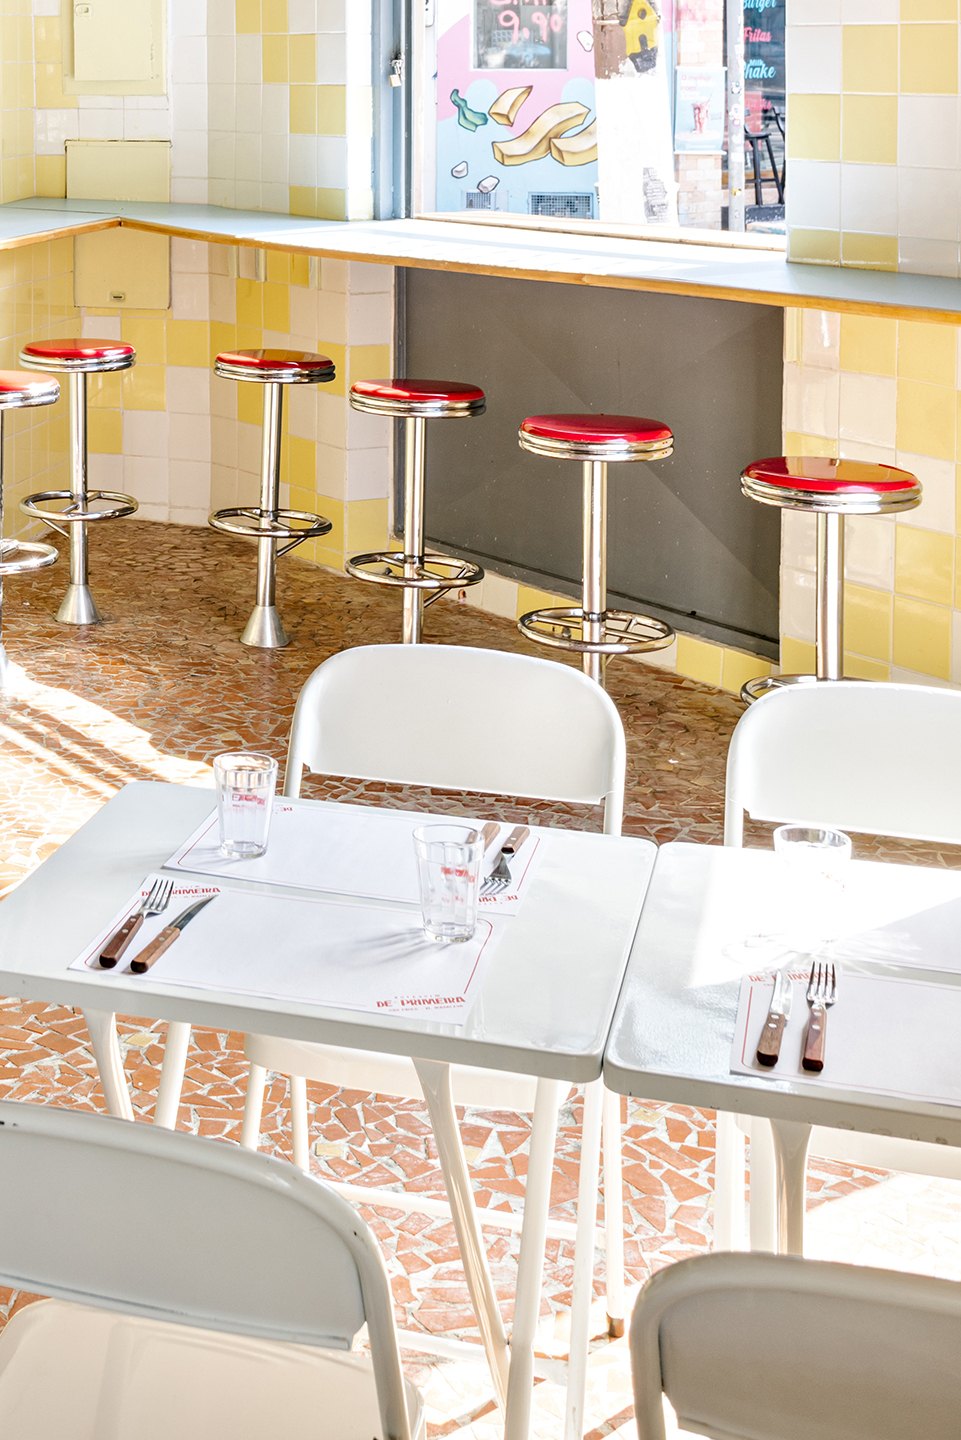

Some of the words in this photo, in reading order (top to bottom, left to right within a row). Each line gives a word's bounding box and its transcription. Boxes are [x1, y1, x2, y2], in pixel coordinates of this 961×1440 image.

[498, 9, 563, 45] 9.90
[376, 1000, 393, 1008] DE
[400, 996, 466, 1006] PRIMEIRA
